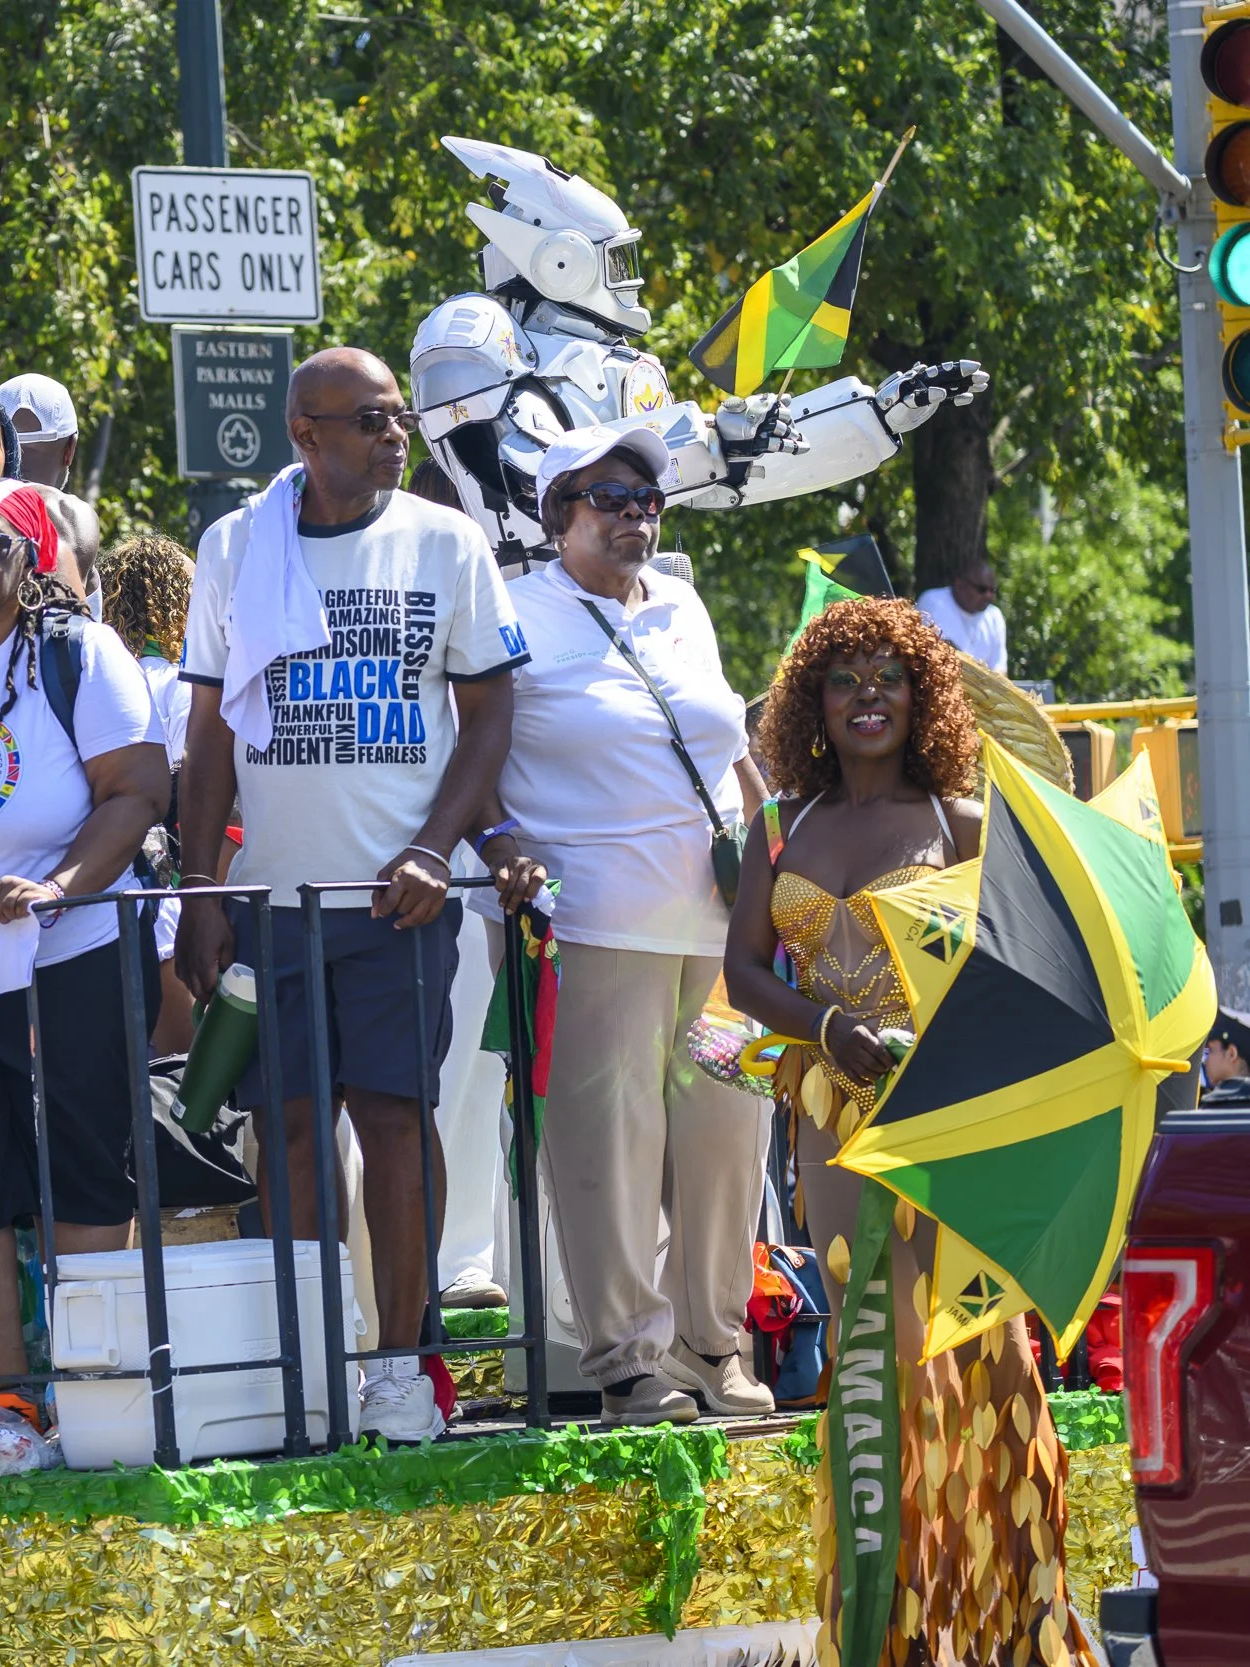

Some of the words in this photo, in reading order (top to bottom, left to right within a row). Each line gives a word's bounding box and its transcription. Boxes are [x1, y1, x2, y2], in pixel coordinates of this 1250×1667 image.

[150, 192, 302, 235] PASSENGER
[153, 251, 221, 290] CARS
[241, 253, 304, 292] ONLY
[196, 341, 272, 358] EASTERN
[196, 367, 275, 384] PARKWAY
[209, 393, 266, 410] MALLS
[325, 589, 401, 608] GRATEFUL
[327, 607, 401, 627] AMAZING
[290, 628, 402, 659] NDSOME
[402, 590, 436, 700] BLESSED
[289, 659, 402, 702] BLACK
[273, 702, 356, 724] THANKFUL
[357, 702, 426, 745] DAD
[272, 724, 333, 738] POWERFUL
[335, 724, 356, 764] KIND
[357, 745, 427, 764] FEARLESS
